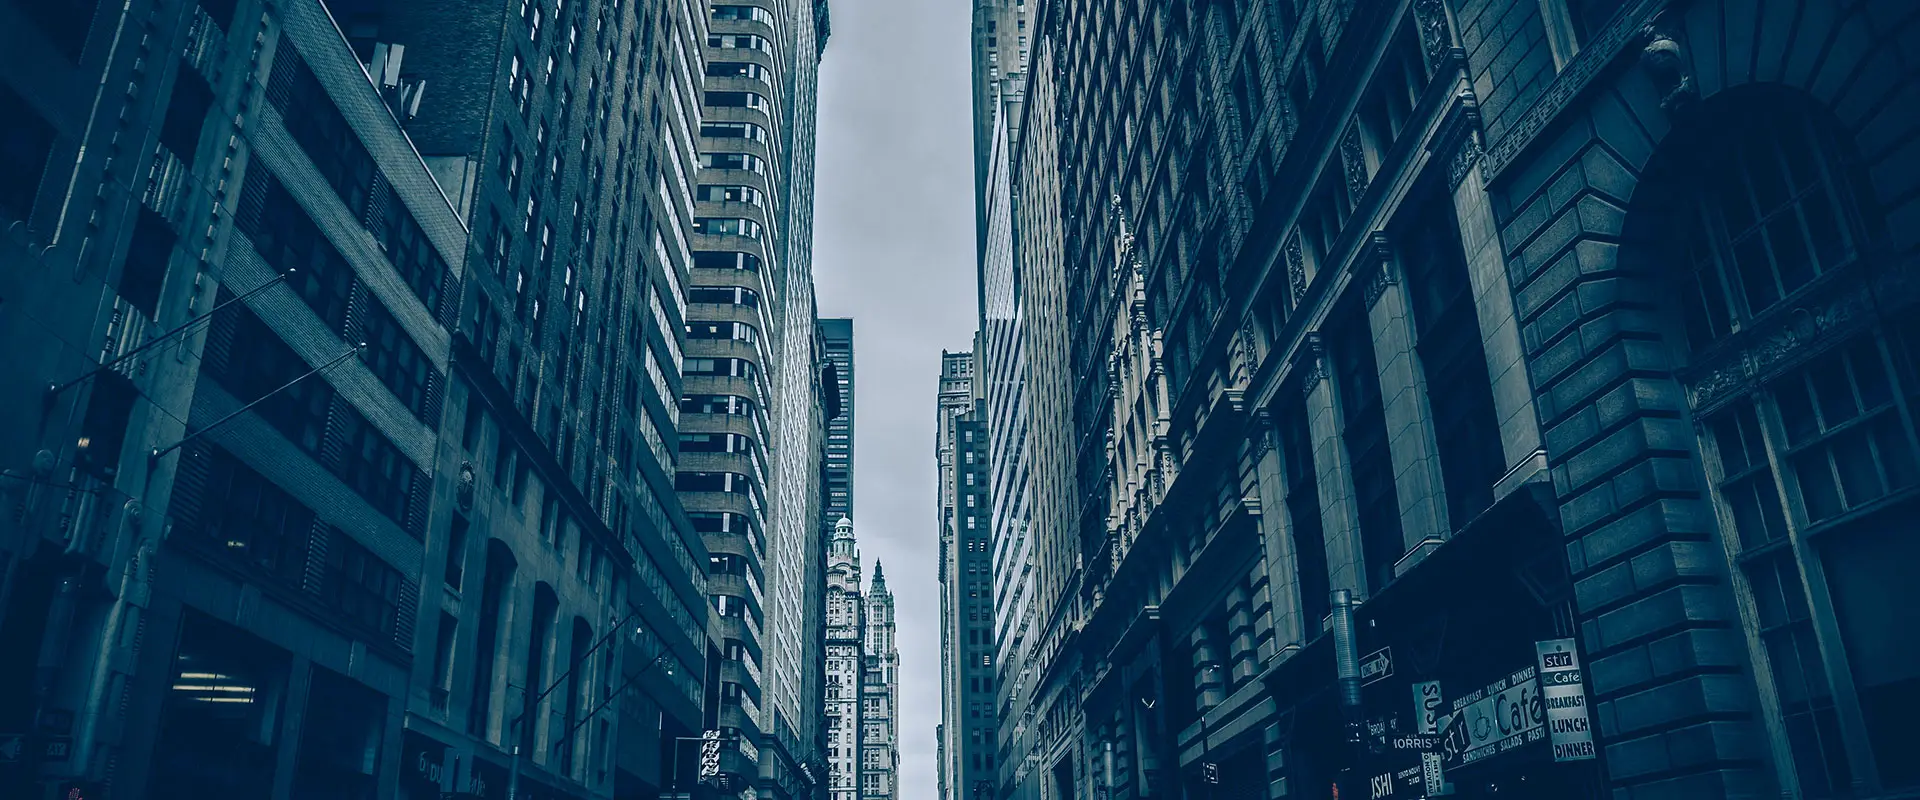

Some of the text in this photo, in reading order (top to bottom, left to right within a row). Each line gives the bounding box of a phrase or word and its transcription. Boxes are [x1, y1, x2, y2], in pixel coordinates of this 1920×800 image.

[1554, 671, 1580, 683] Café
[1453, 689, 1482, 710] BREAKFAST
[1487, 678, 1507, 695] LUNCH
[1546, 695, 1585, 709] BREAKFAST
[1496, 685, 1542, 736] Café
[1552, 717, 1588, 733] LUNCH
[1463, 744, 1495, 763] SANDWICHES
[1500, 734, 1522, 751] SALADS
[1555, 741, 1595, 759] DINNER
[1425, 762, 1434, 794] NOUVEAU
